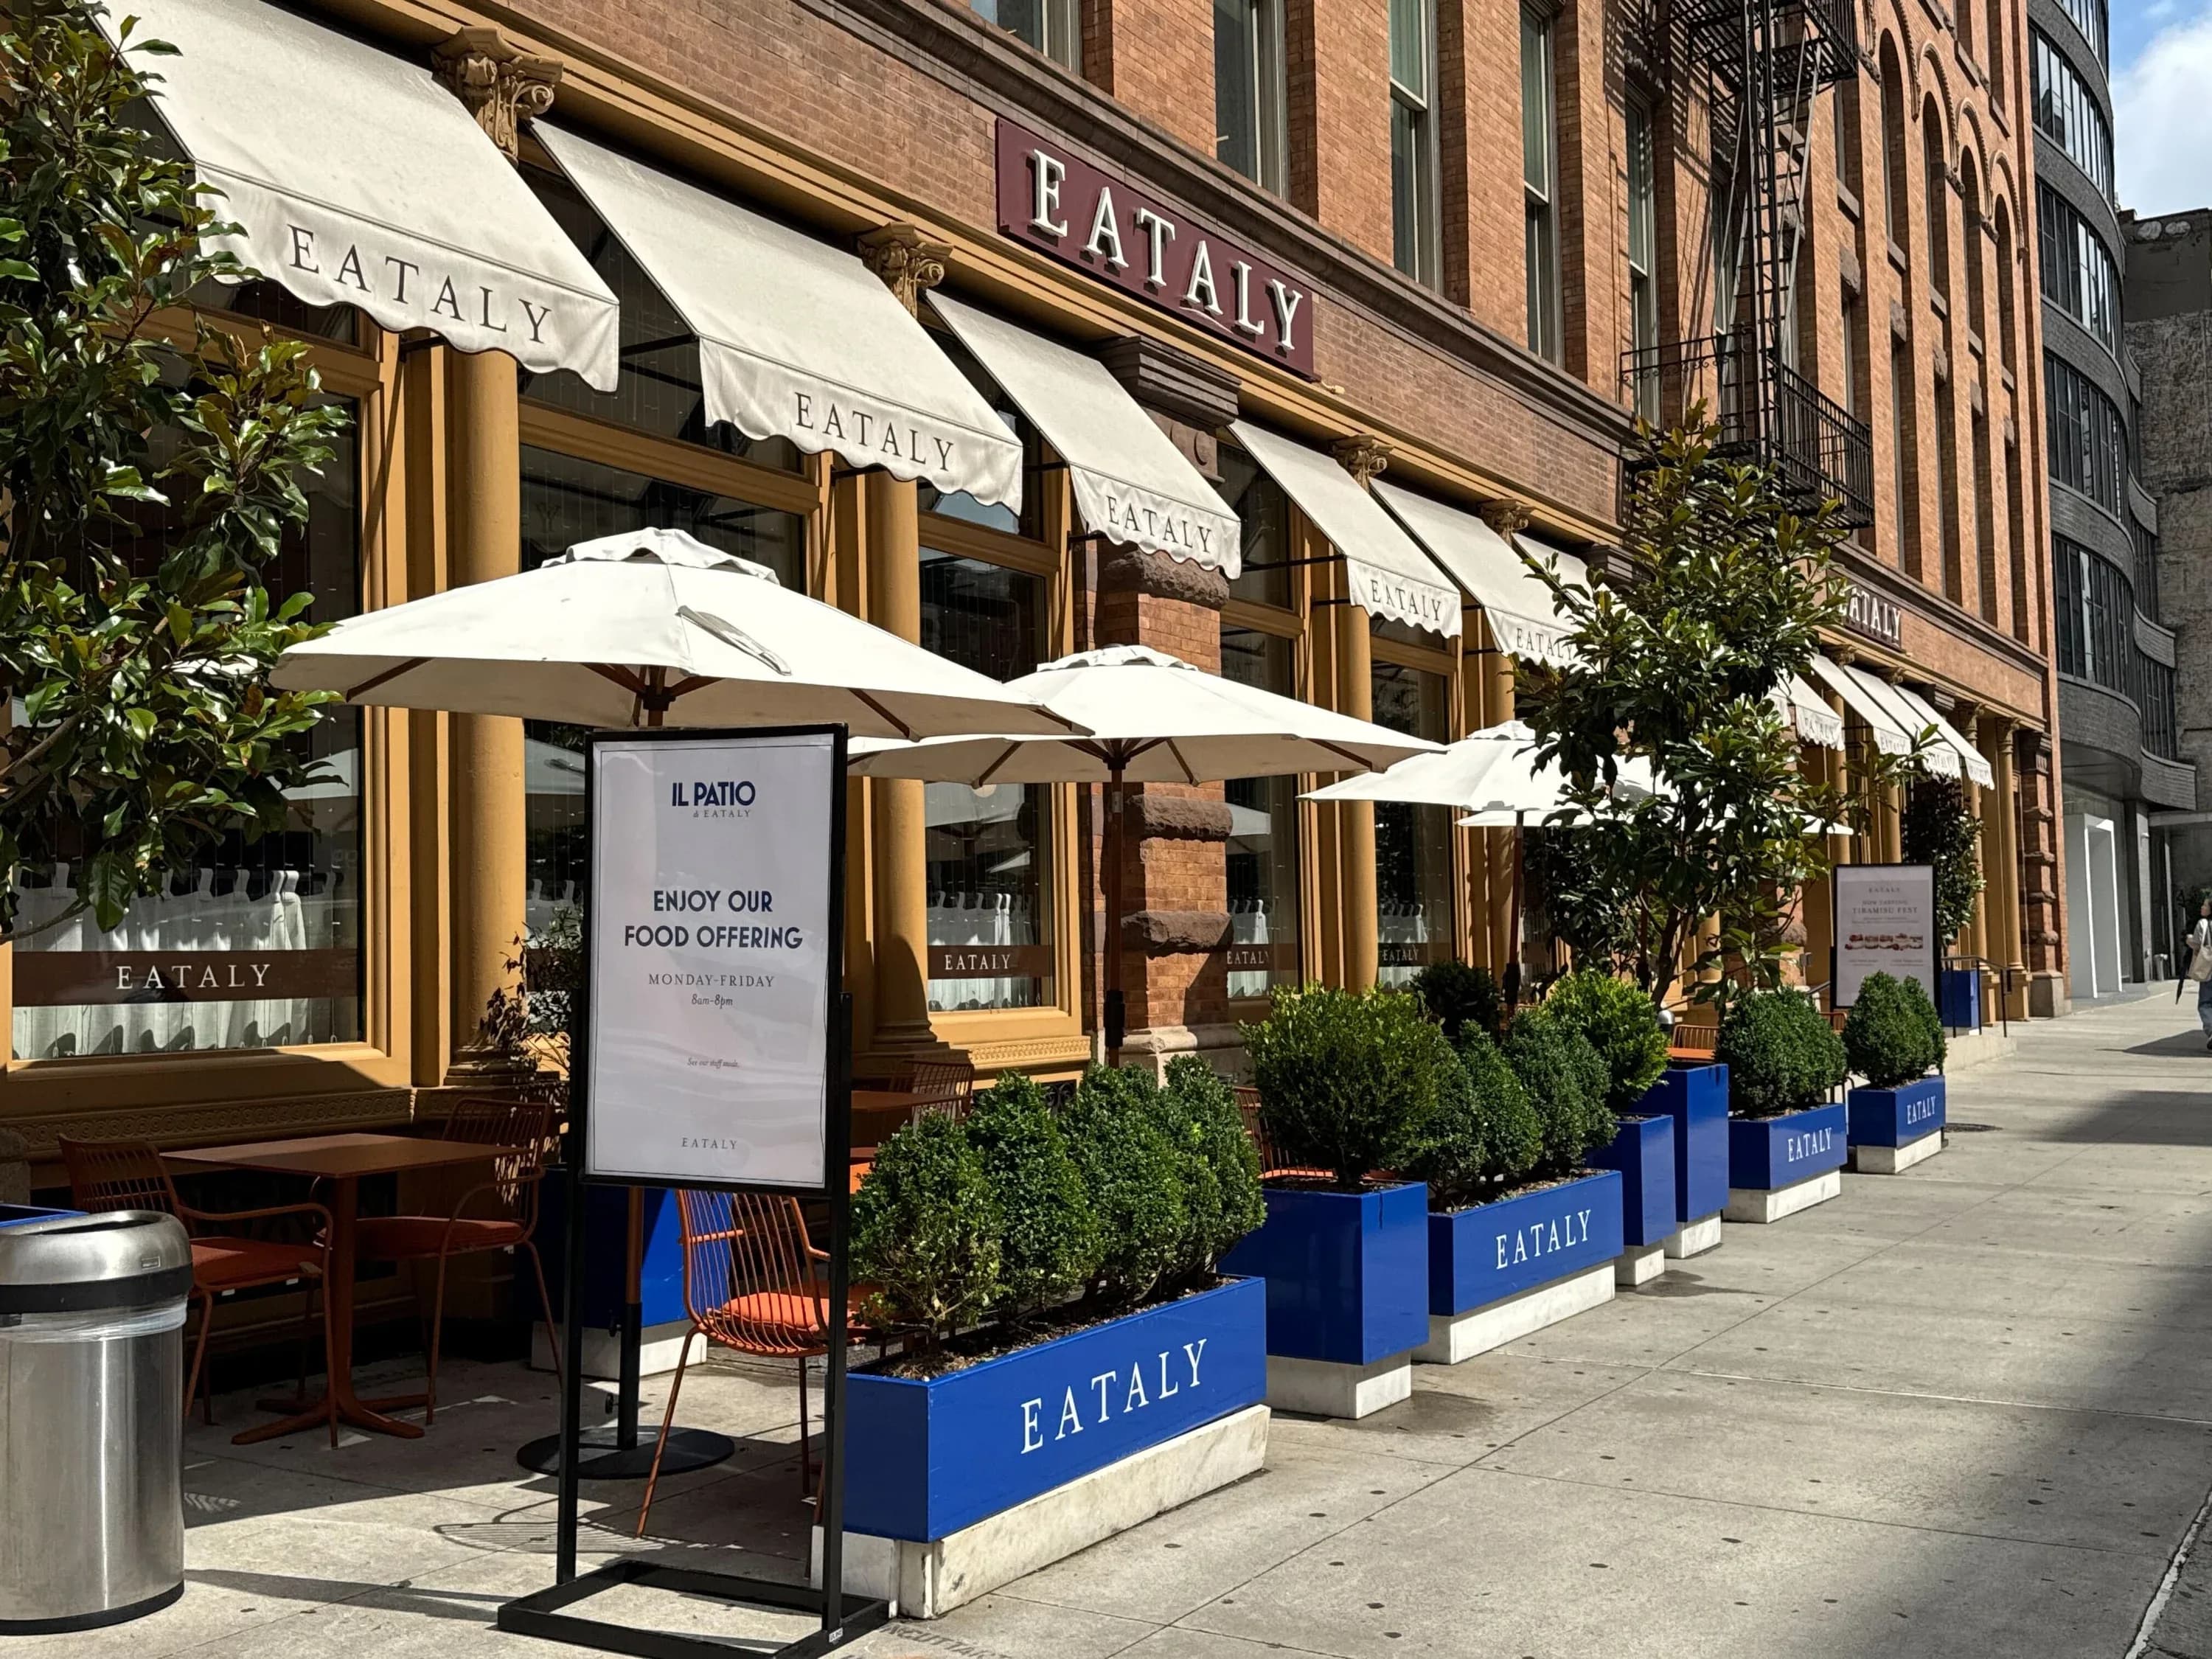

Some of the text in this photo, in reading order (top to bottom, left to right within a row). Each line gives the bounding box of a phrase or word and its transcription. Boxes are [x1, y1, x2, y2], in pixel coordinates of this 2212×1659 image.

[1031, 148, 1304, 352] EATALY
[286, 223, 554, 345] EATALY
[793, 392, 956, 473] EATALY
[1106, 494, 1214, 554] EATALY
[1371, 579, 1441, 622] EATALY
[672, 781, 756, 807] IL PATIO
[703, 809, 751, 818] EATALY
[653, 889, 773, 913] ENJOY OUR
[625, 925, 803, 949] FOOD OFFERING
[944, 953, 1011, 971] EATALY
[1382, 949, 1419, 961] EATALY
[115, 964, 271, 990] EATALY
[648, 973, 775, 987] MONDAY-FRIDAY
[691, 993, 734, 1009] 8am-8pm
[1906, 1095, 1936, 1124] EATALY
[681, 1137, 738, 1150] EATALY
[1787, 1127, 1833, 1163] EATALY
[1494, 1208, 1593, 1270] EATALY
[1019, 1338, 1209, 1455] EATALY
